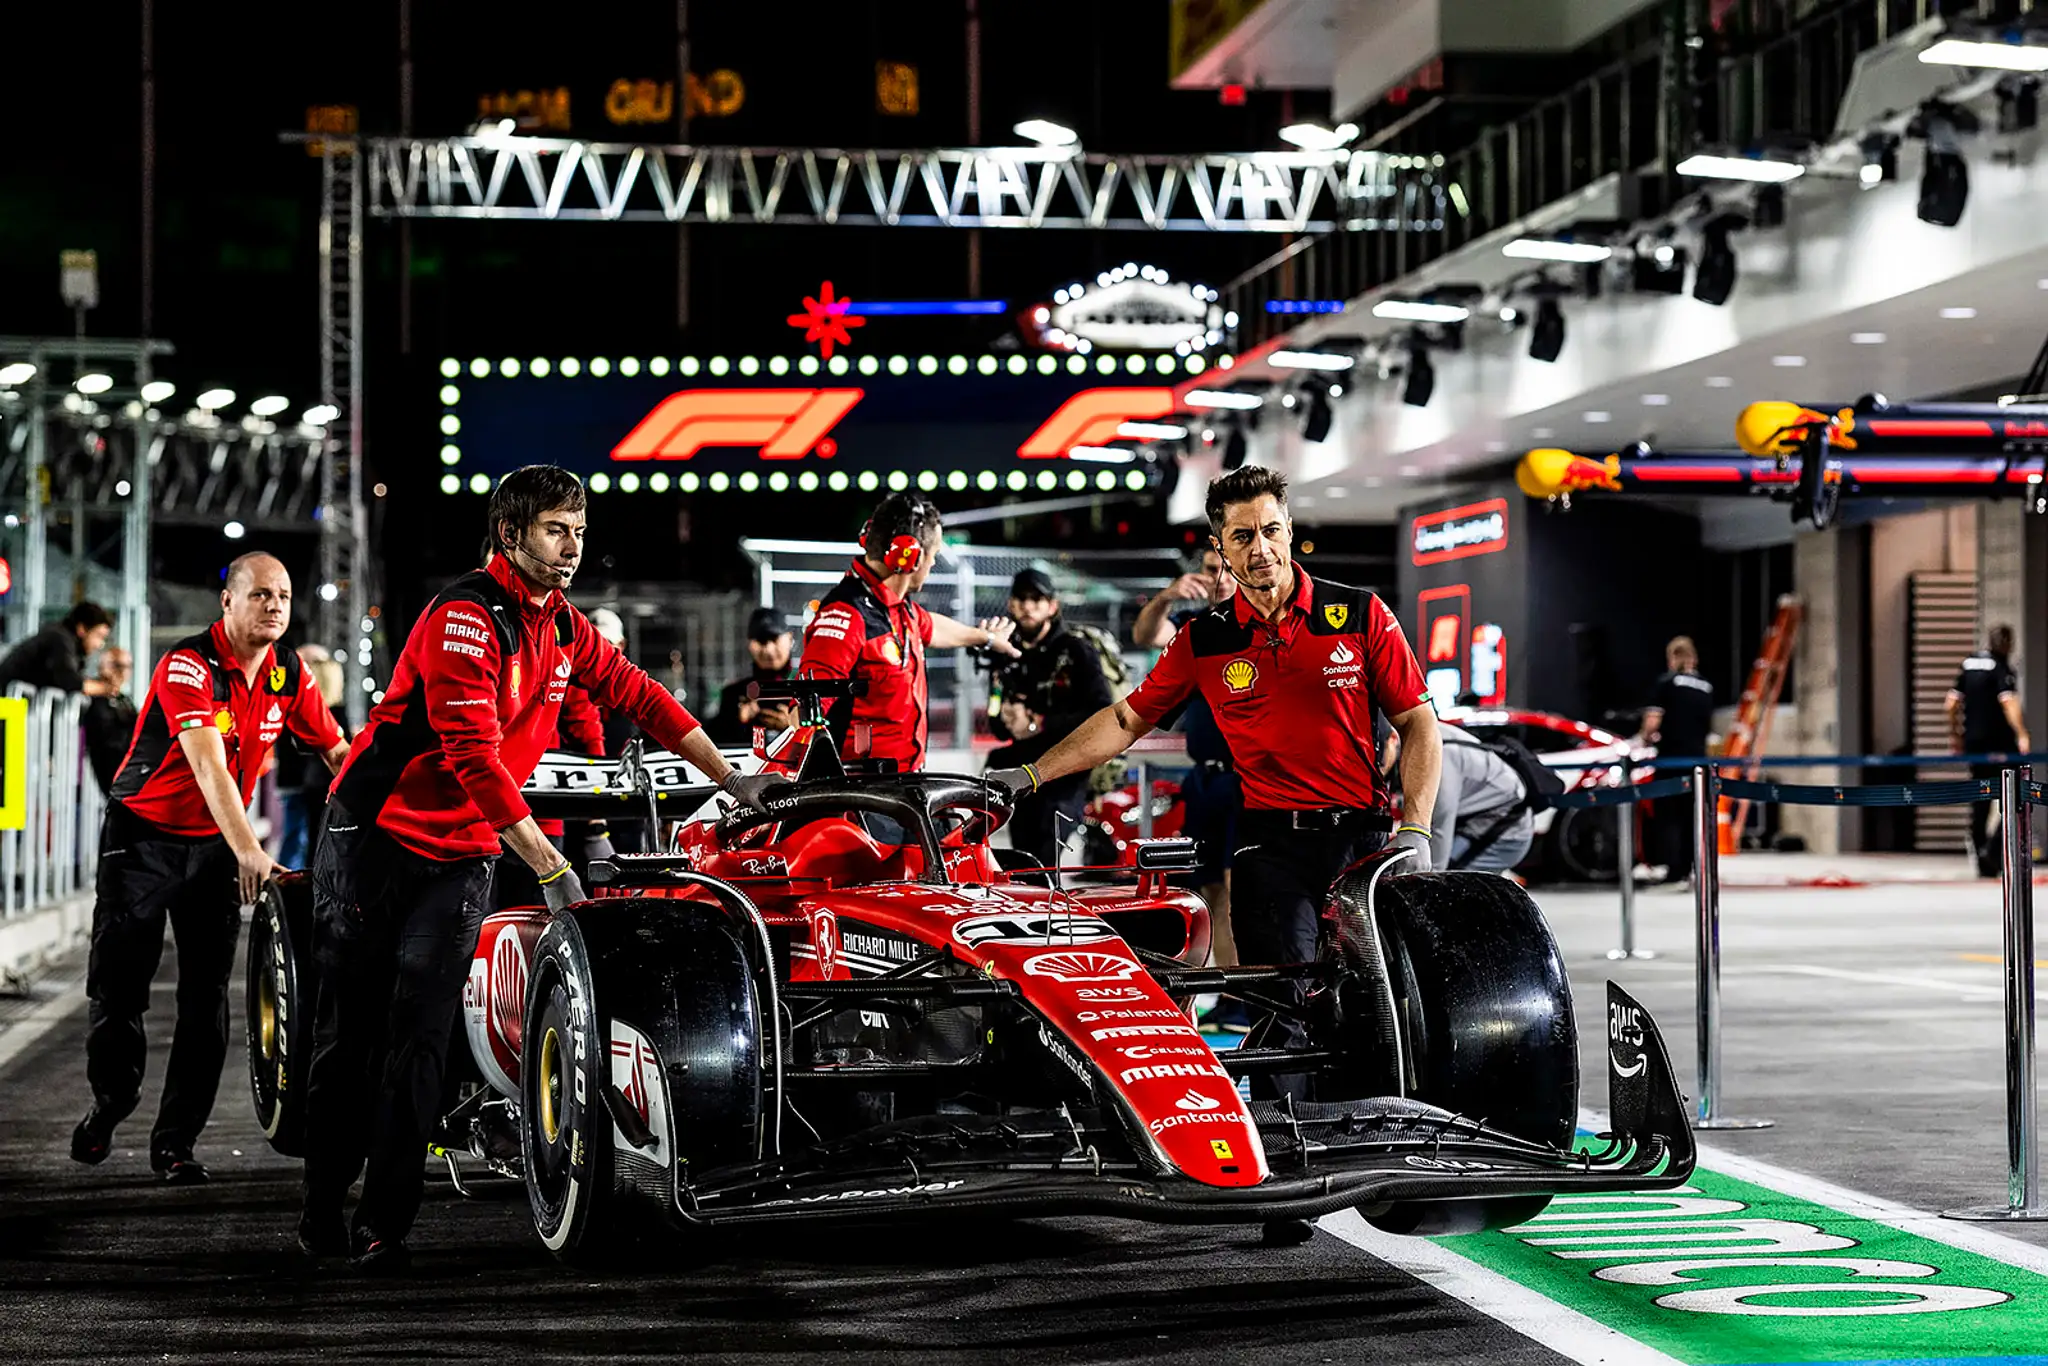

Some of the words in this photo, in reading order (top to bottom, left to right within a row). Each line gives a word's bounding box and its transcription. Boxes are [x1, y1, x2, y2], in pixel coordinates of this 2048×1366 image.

[445, 623, 490, 643] MAHLE
[1323, 664, 1362, 675] Santander
[740, 797, 799, 817] TECOLOGY
[742, 855, 787, 874] Ray-Ban
[953, 914, 1119, 949] 16
[843, 932, 886, 957] RICHARD
[888, 939, 919, 962] MILLE
[274, 943, 288, 1056] ZERO
[1076, 987, 1143, 997] aws
[1100, 1008, 1180, 1019] Palantir
[1609, 1002, 1644, 1046] aws
[565, 970, 588, 1107] ZERO
[1090, 1025, 1199, 1042] PIRELLI
[1120, 1064, 1230, 1085] MAHLE
[1150, 1112, 1250, 1136] Santande
[800, 1180, 964, 1203] V-Power
